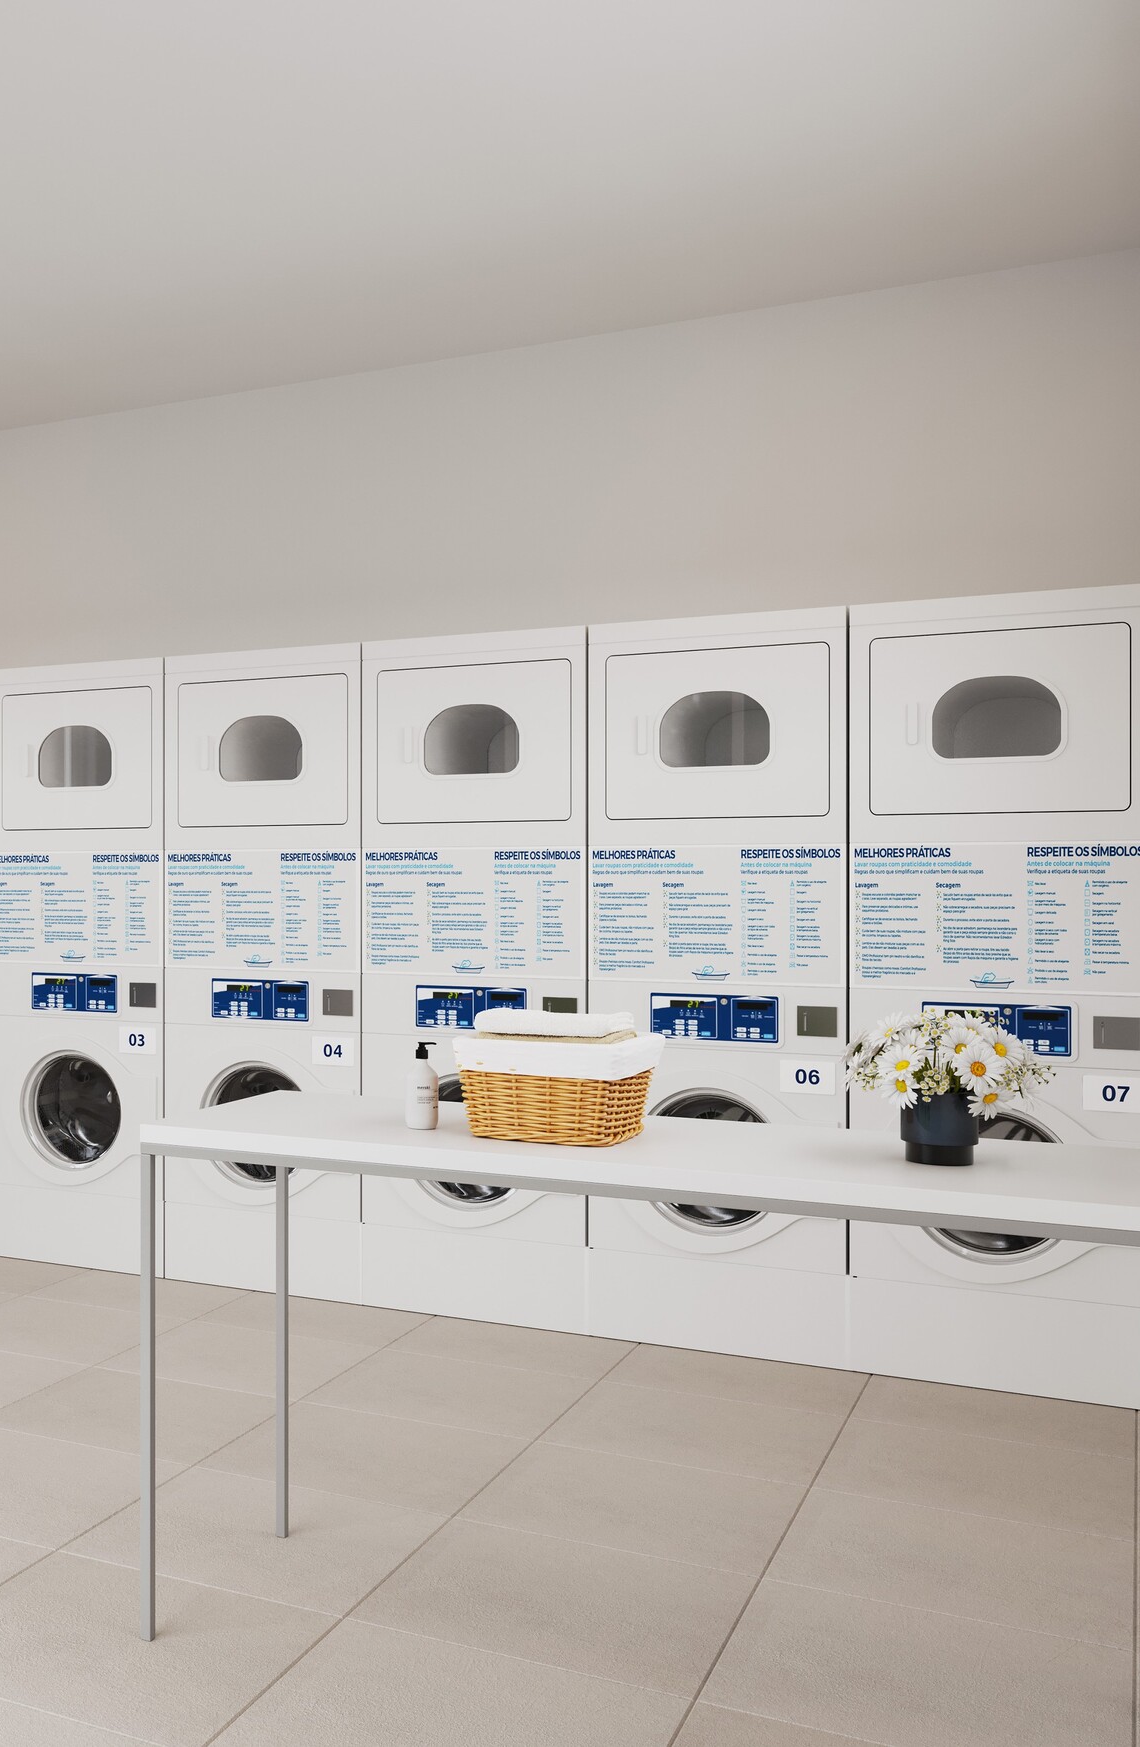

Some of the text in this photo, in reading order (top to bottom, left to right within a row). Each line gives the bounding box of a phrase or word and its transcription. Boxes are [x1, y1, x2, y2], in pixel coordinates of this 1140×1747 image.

[92, 852, 158, 862] RESPEITE OS SÍMBOLOS
[168, 852, 231, 862] MELHORES PRÁTICAS
[280, 850, 356, 861] RESPEITE OS SÍMBOLOS
[366, 850, 438, 861] MELHORES PRÁTICAS
[494, 848, 580, 860] RESPEITE OS SÍMBOLOS
[592, 848, 676, 860] MELHORES PRÁTICAS
[741, 846, 840, 858] RESPEITE OS SÍMBOLOS
[854, 845, 951, 858] MELHORES PRÁTICAS
[1028, 846, 1074, 857] RESPEITE
[1075, 846, 1089, 856] OS
[23, 853, 49, 863] PRÁTICAS
[128, 1034, 144, 1046] 03
[324, 1044, 342, 1058] 04
[796, 1068, 820, 1085] 06
[1102, 1085, 1130, 1102] 07
